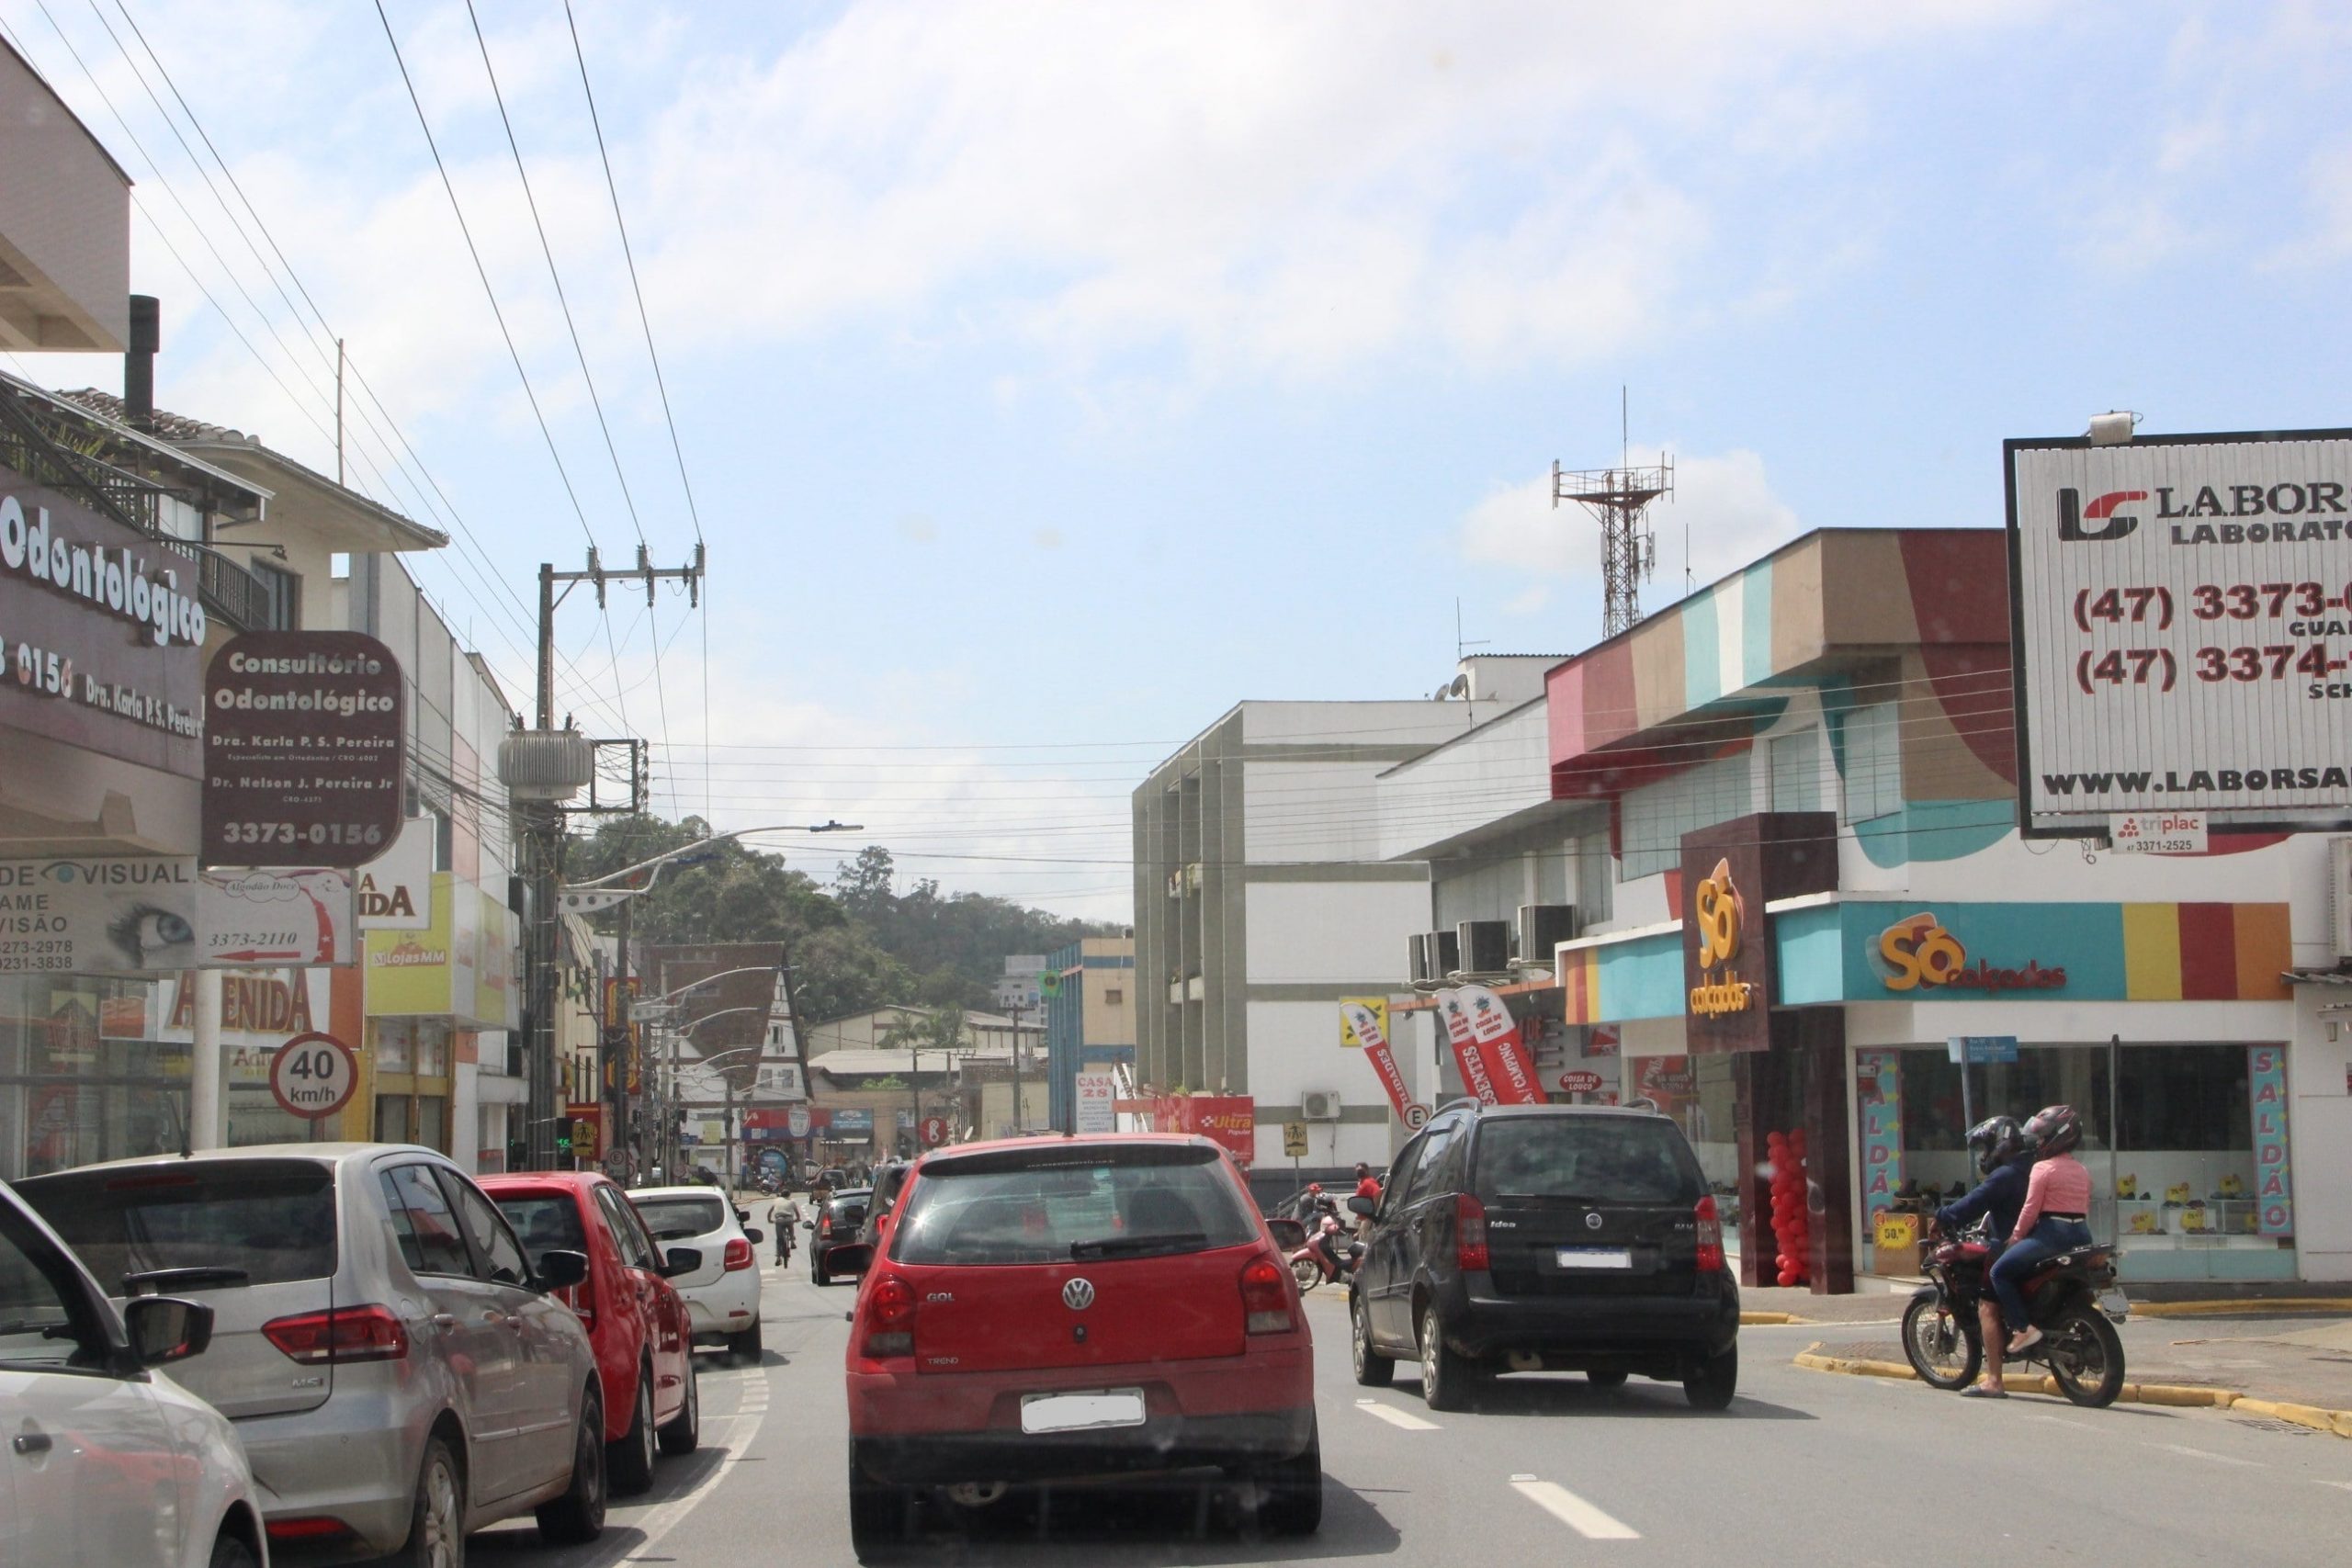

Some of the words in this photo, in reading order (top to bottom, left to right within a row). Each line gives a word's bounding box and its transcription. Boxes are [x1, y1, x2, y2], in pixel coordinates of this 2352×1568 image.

[2156, 482, 2352, 518] LABOR
[0, 495, 206, 647] Odontológico
[2074, 586, 2175, 633] (47)
[2289, 621, 2352, 637] GUA
[17, 642, 74, 698] 0156
[229, 650, 382, 675] Consultório
[2076, 648, 2177, 694] (47)
[2196, 643, 2352, 682] 3374-
[86, 673, 110, 708] Dra.
[113, 684, 142, 719] Karla
[167, 703, 204, 739] Pereira
[214, 687, 394, 717] Odontológico
[212, 735, 245, 747] Dra.
[252, 735, 294, 747] Karla
[300, 735, 311, 748] P.
[317, 736, 330, 748] S.
[336, 735, 394, 748] Pereira
[212, 777, 232, 788] Dr.
[240, 777, 292, 788] Nelson
[298, 778, 309, 789] J.
[315, 776, 372, 789] Pereira
[379, 778, 393, 789] Jr
[2042, 767, 2352, 795] WWW.LABORSA
[223, 822, 381, 845] 3373-0156
[2141, 814, 2199, 835] triplac
[2136, 840, 2192, 852] 3371-2525
[84, 863, 188, 885] VISUAL
[0, 914, 67, 933] ISÃO
[0, 940, 73, 954] 273-2978
[209, 931, 298, 947] 3373-2110
[1945, 958, 2067, 993] calçados
[168, 967, 314, 1034] AENIDA
[290, 1049, 334, 1080] 40
[1498, 1042, 1527, 1089] CAMPING
[1078, 1077, 1114, 1087] CASA
[290, 1086, 335, 1103] km/h
[1213, 1114, 1251, 1129] Ultra
[1411, 1110, 1421, 1125] E
[2255, 1052, 2288, 1226] SALDÃO
[1490, 1220, 1516, 1229] Idea
[926, 1292, 956, 1303] GOL
[927, 1357, 959, 1365] TREND
